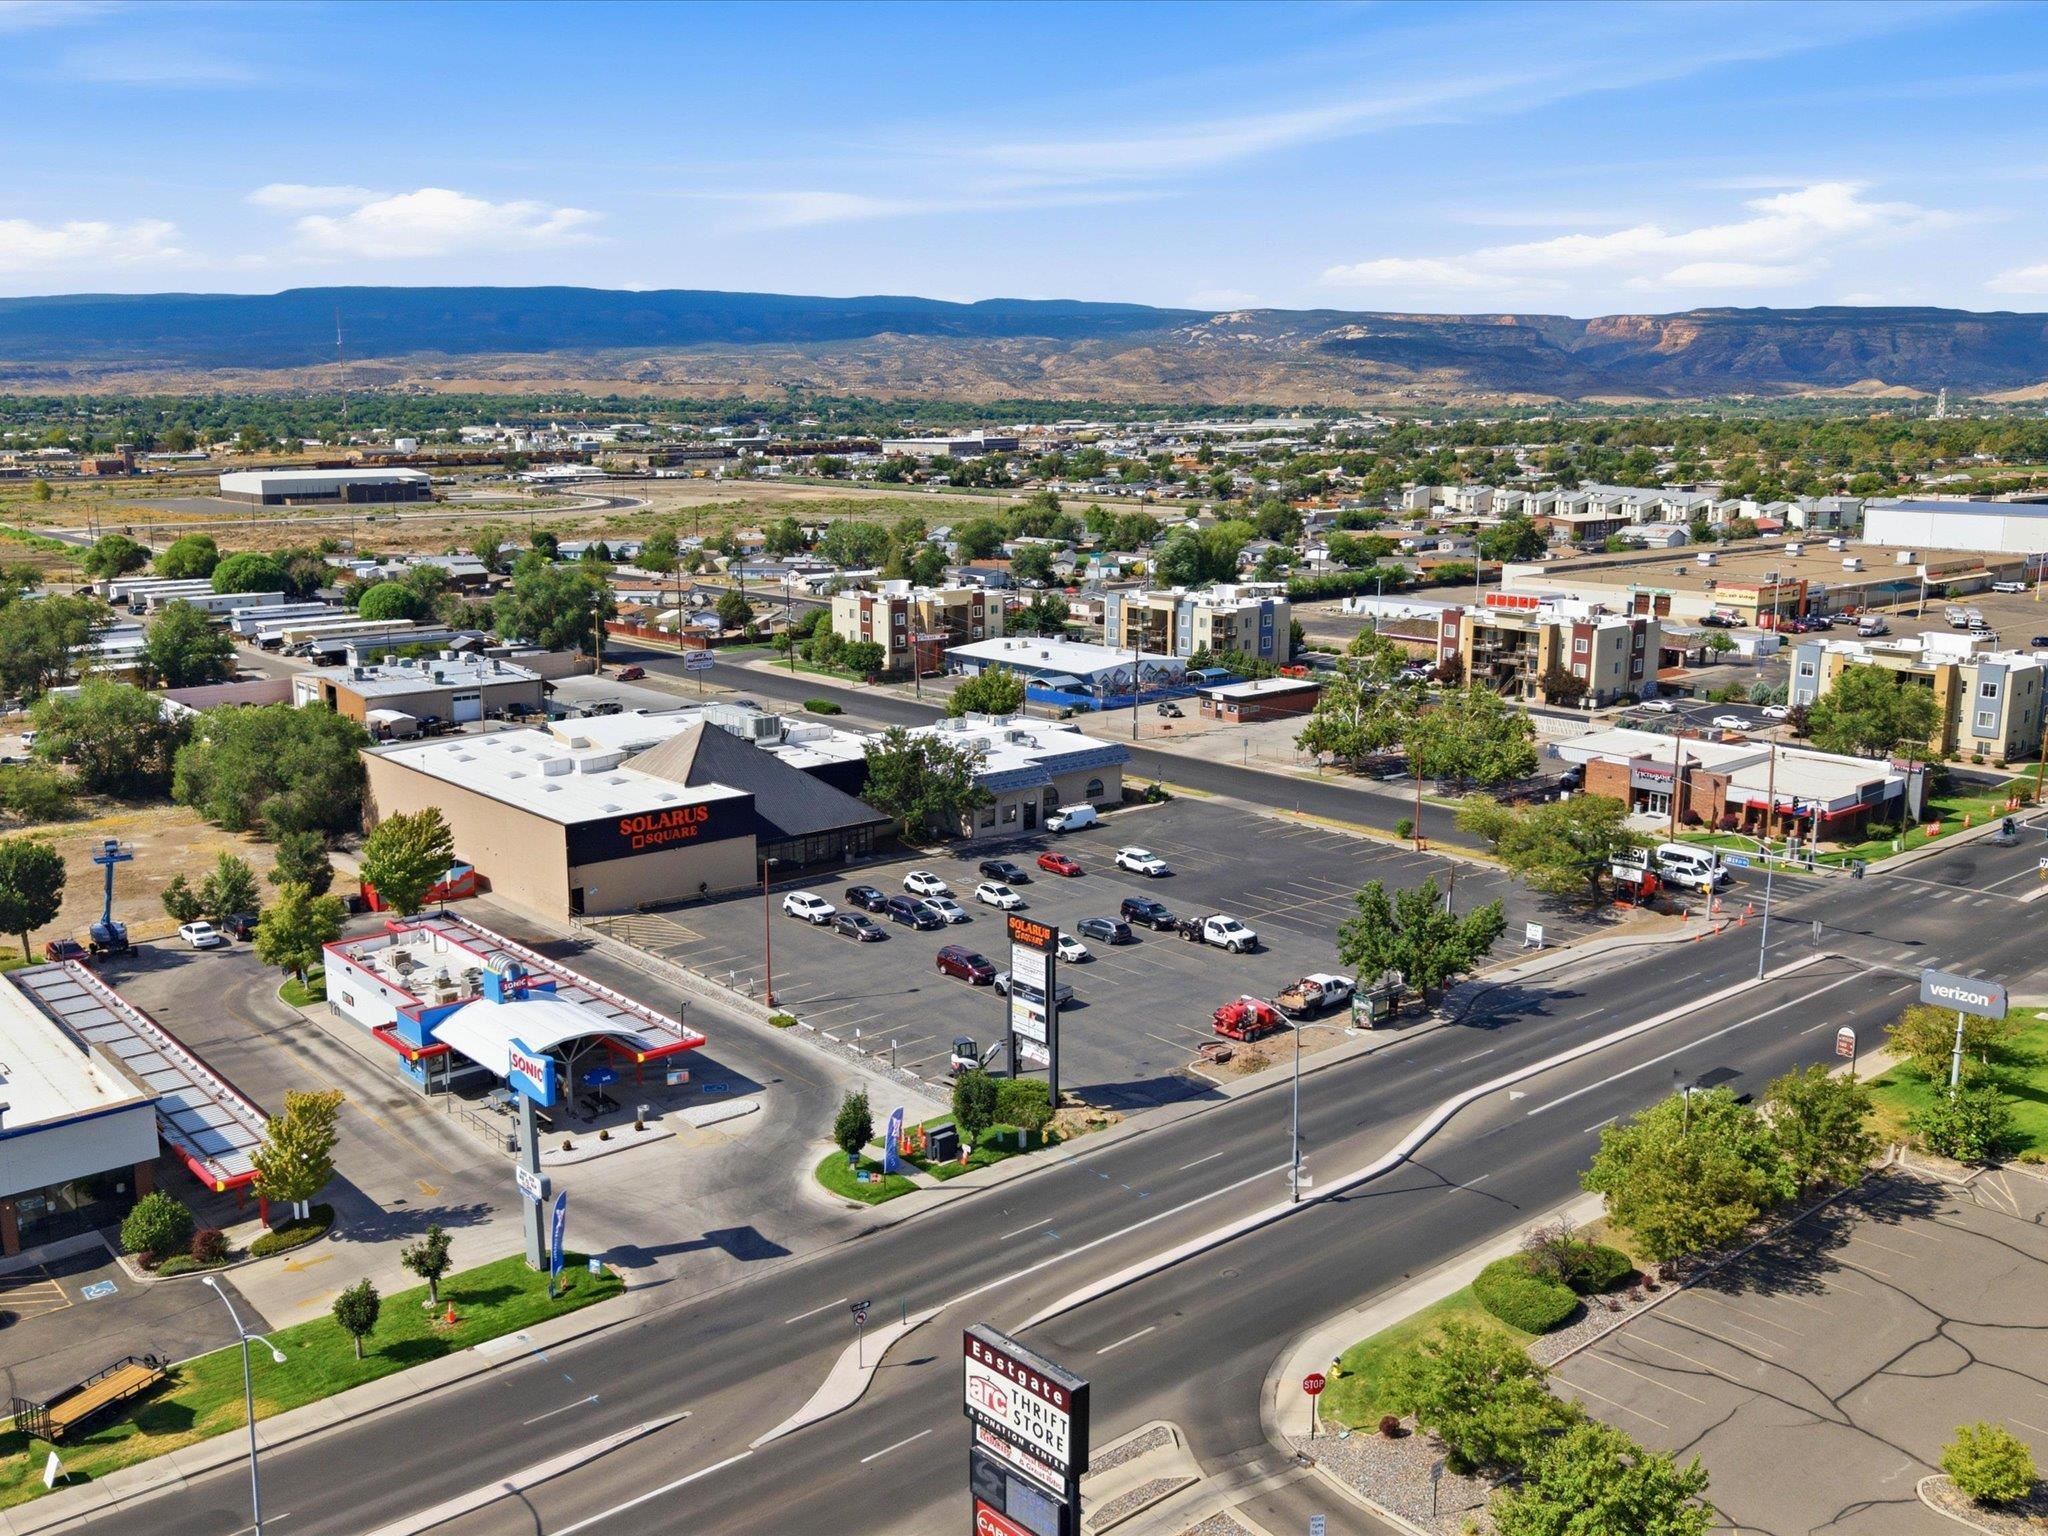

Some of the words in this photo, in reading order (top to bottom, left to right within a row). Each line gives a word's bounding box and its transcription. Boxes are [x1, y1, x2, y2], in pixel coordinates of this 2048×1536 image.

[619, 805, 709, 836] SOLARUS
[645, 825, 698, 844] SQUARE
[1009, 917, 1051, 940] SOLARUS
[504, 978, 526, 990] SONIC
[1929, 983, 1989, 1007] verizon
[511, 1053, 544, 1083] SONIC
[972, 1340, 1063, 1405] Eastgate
[1304, 1379, 1325, 1389] STOP
[970, 1380, 1007, 1416] arc
[1011, 1388, 1068, 1436] THRIFT
[978, 1412, 1025, 1446] DONATION
[1029, 1444, 1065, 1472] CENTER
[1014, 1409, 1064, 1453] STORE
